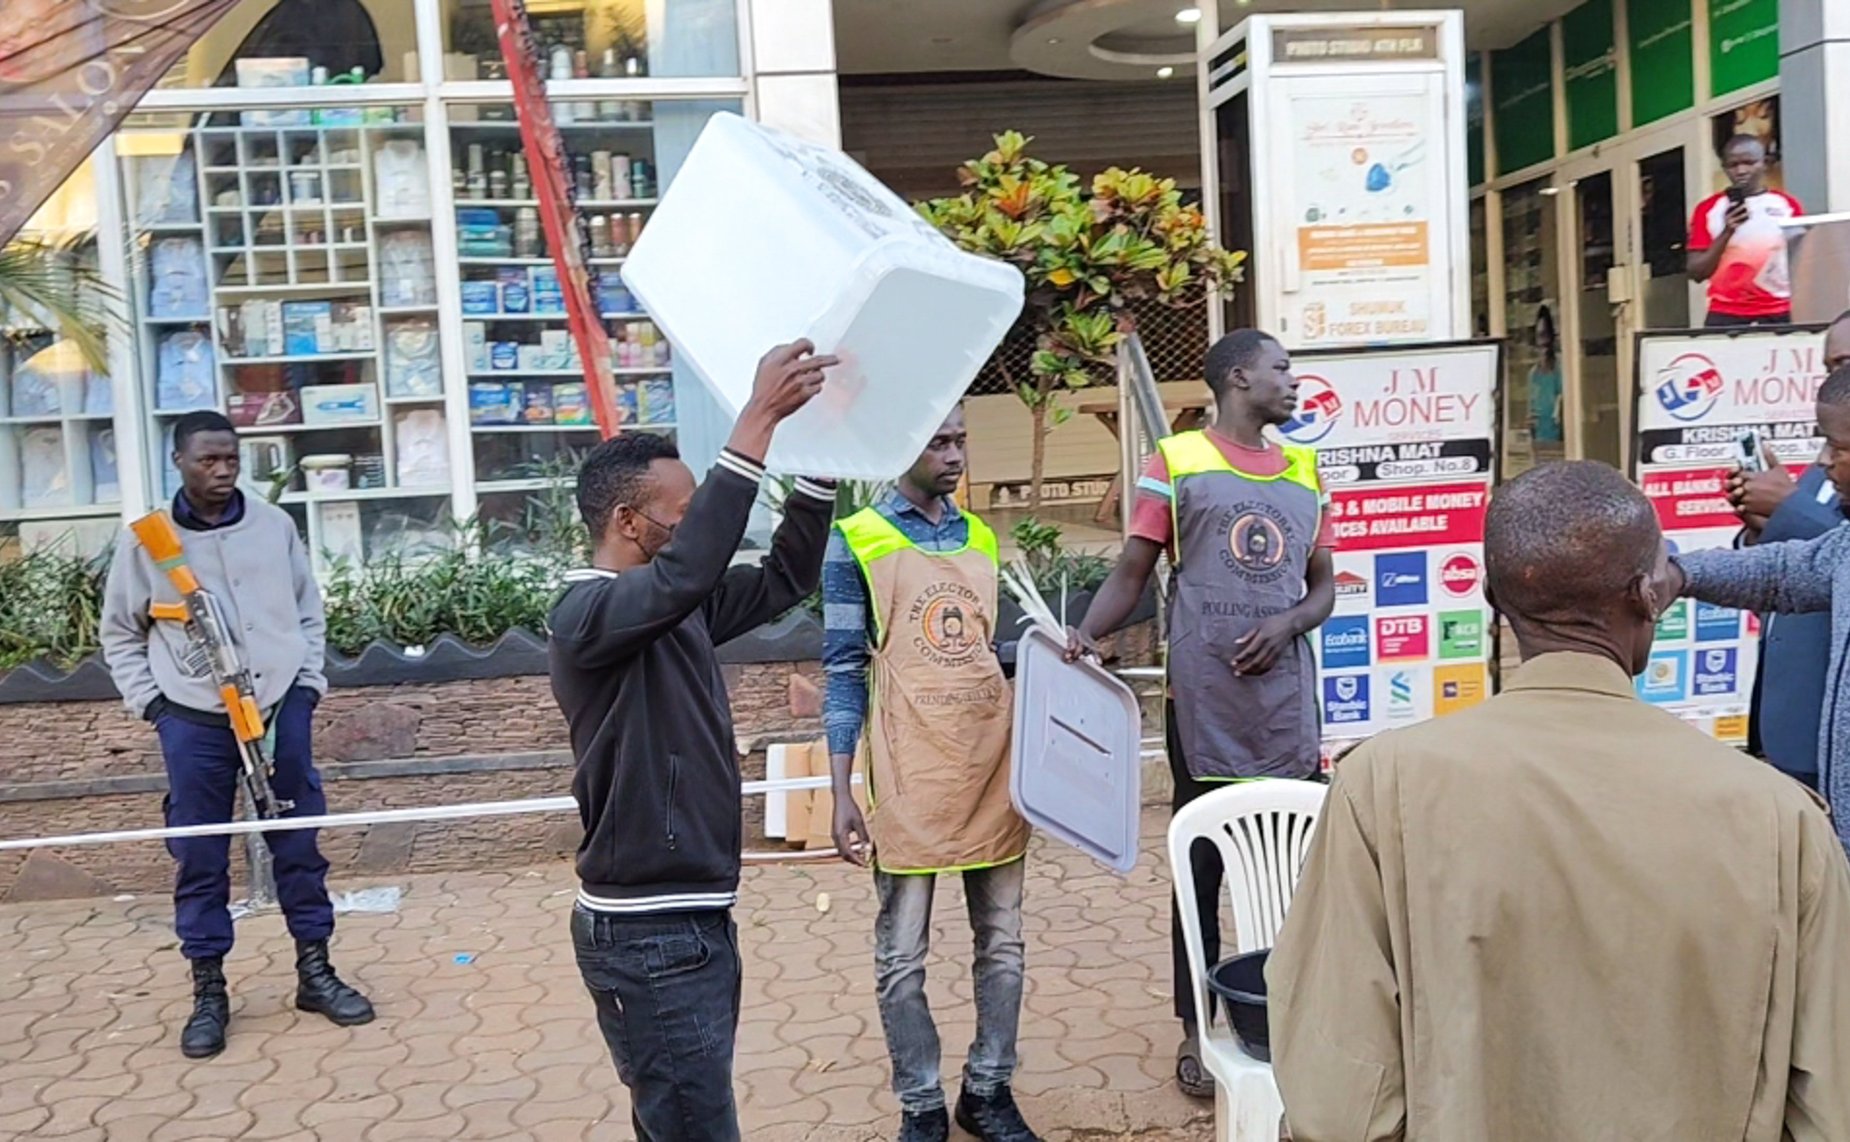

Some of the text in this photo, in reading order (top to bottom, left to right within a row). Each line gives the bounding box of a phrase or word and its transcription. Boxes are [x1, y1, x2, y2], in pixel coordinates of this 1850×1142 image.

[1733, 374, 1826, 406] MONE
[1353, 393, 1479, 427] MONEY
[1773, 422, 1817, 438] MAT
[1317, 442, 1444, 466] RISHNA MAT
[1686, 446, 1726, 458] Floor
[1322, 469, 1349, 480] oor
[1434, 458, 1472, 473] No.8
[1362, 495, 1423, 515] MOBILE
[1426, 492, 1484, 510] MONEY
[1369, 515, 1448, 536] AVAILABLE
[909, 595, 926, 625] THE
[1202, 601, 1250, 618] POLLING
[1380, 618, 1423, 636] DTB
[1325, 631, 1367, 646] Ecobank
